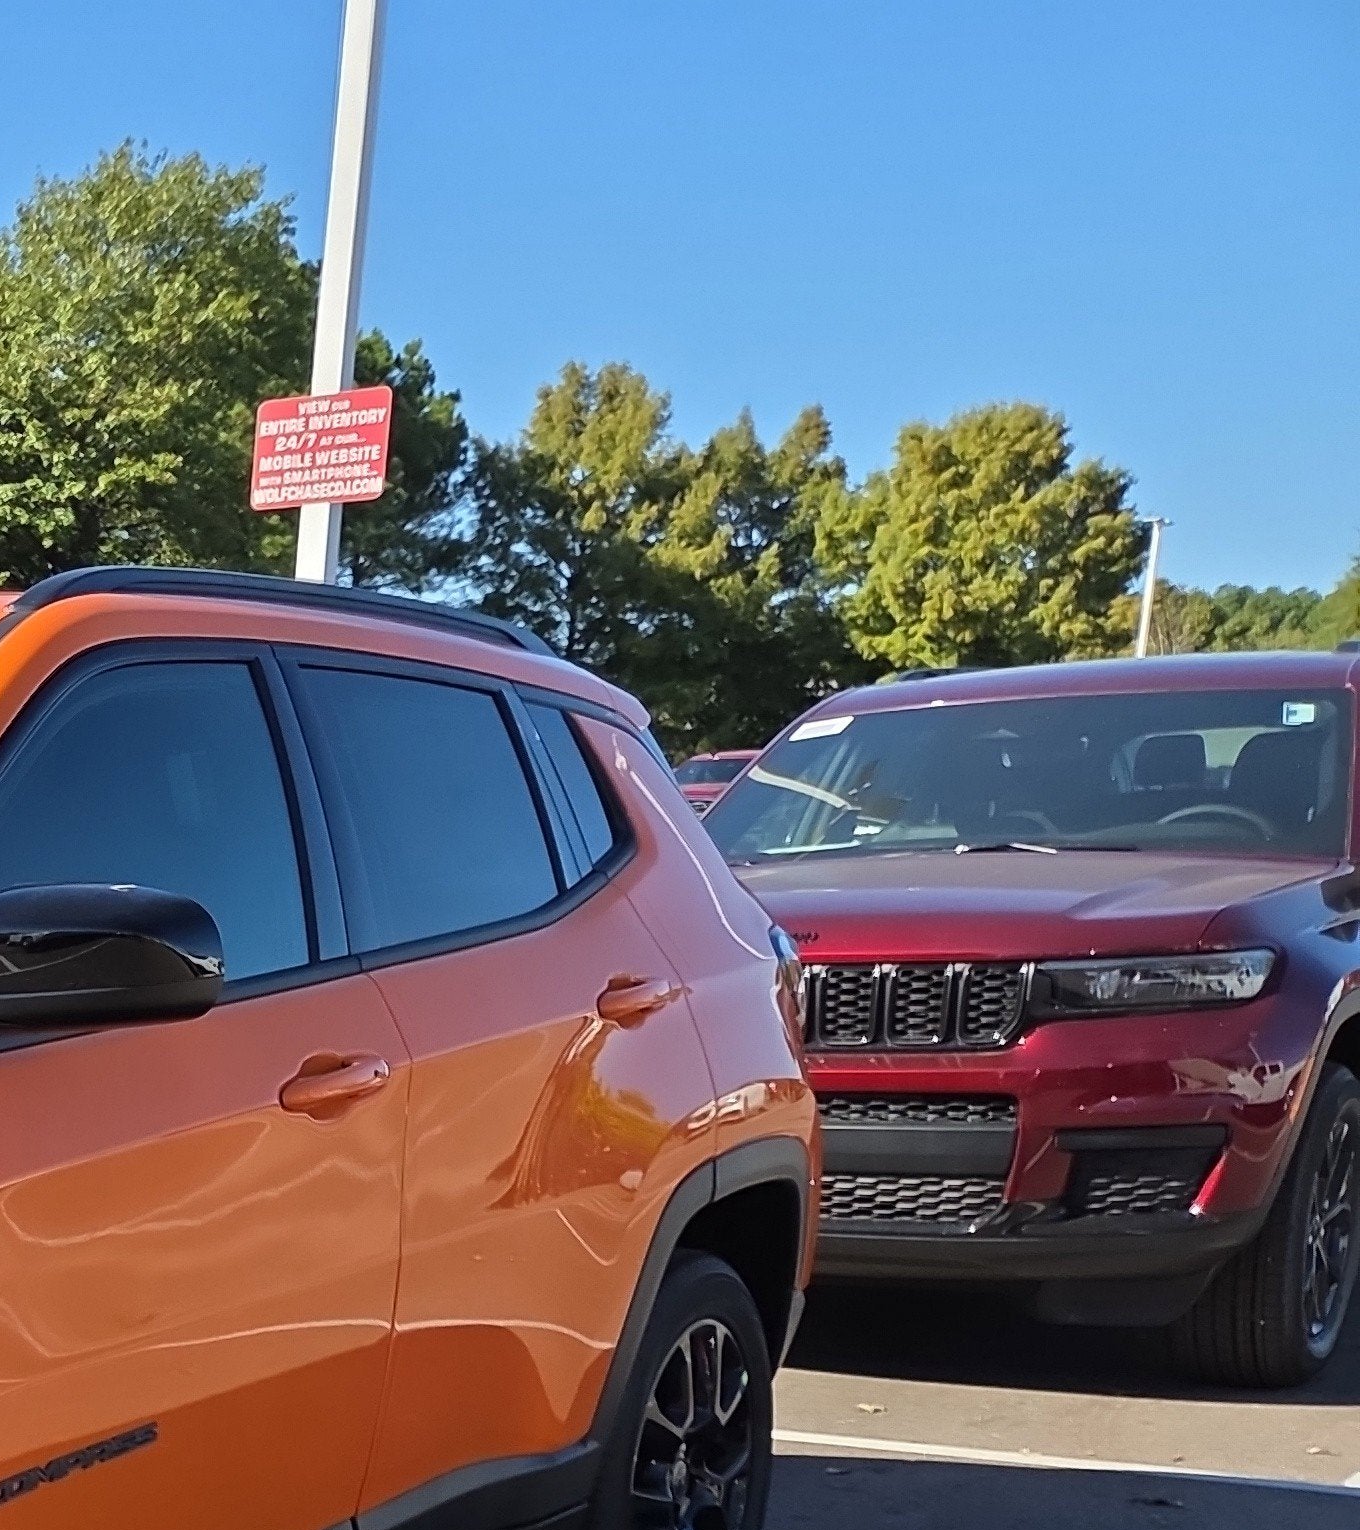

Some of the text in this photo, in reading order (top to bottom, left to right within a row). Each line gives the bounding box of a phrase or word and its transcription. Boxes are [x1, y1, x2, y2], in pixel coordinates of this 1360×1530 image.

[298, 400, 331, 415] VIEW
[259, 408, 387, 437] ENTIRE INVENTORY
[275, 432, 317, 452] 24/7
[258, 444, 382, 472] MOBILE WEBSITE
